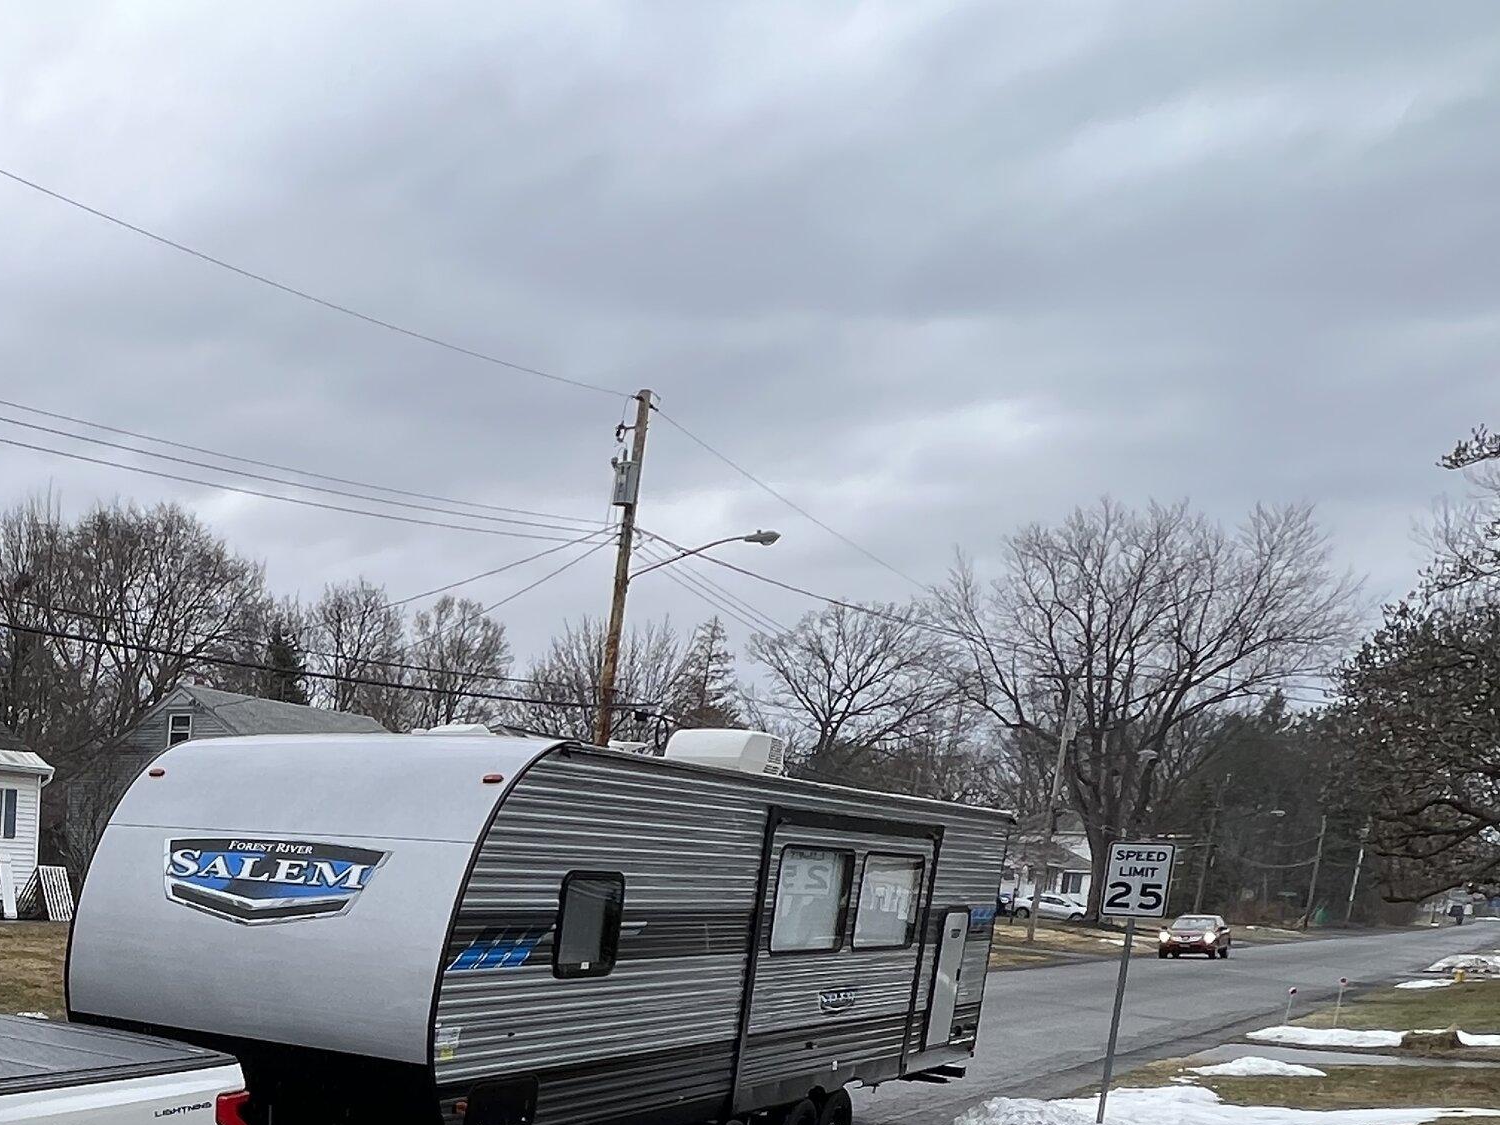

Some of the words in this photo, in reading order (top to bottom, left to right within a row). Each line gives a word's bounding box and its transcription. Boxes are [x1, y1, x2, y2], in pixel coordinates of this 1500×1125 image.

[228, 840, 274, 853] FOREST
[275, 842, 313, 855] RIVER
[1116, 850, 1167, 862] SPEED
[168, 848, 369, 888] SALEM
[1119, 866, 1159, 878] LIMIT
[1105, 881, 1163, 910] 25
